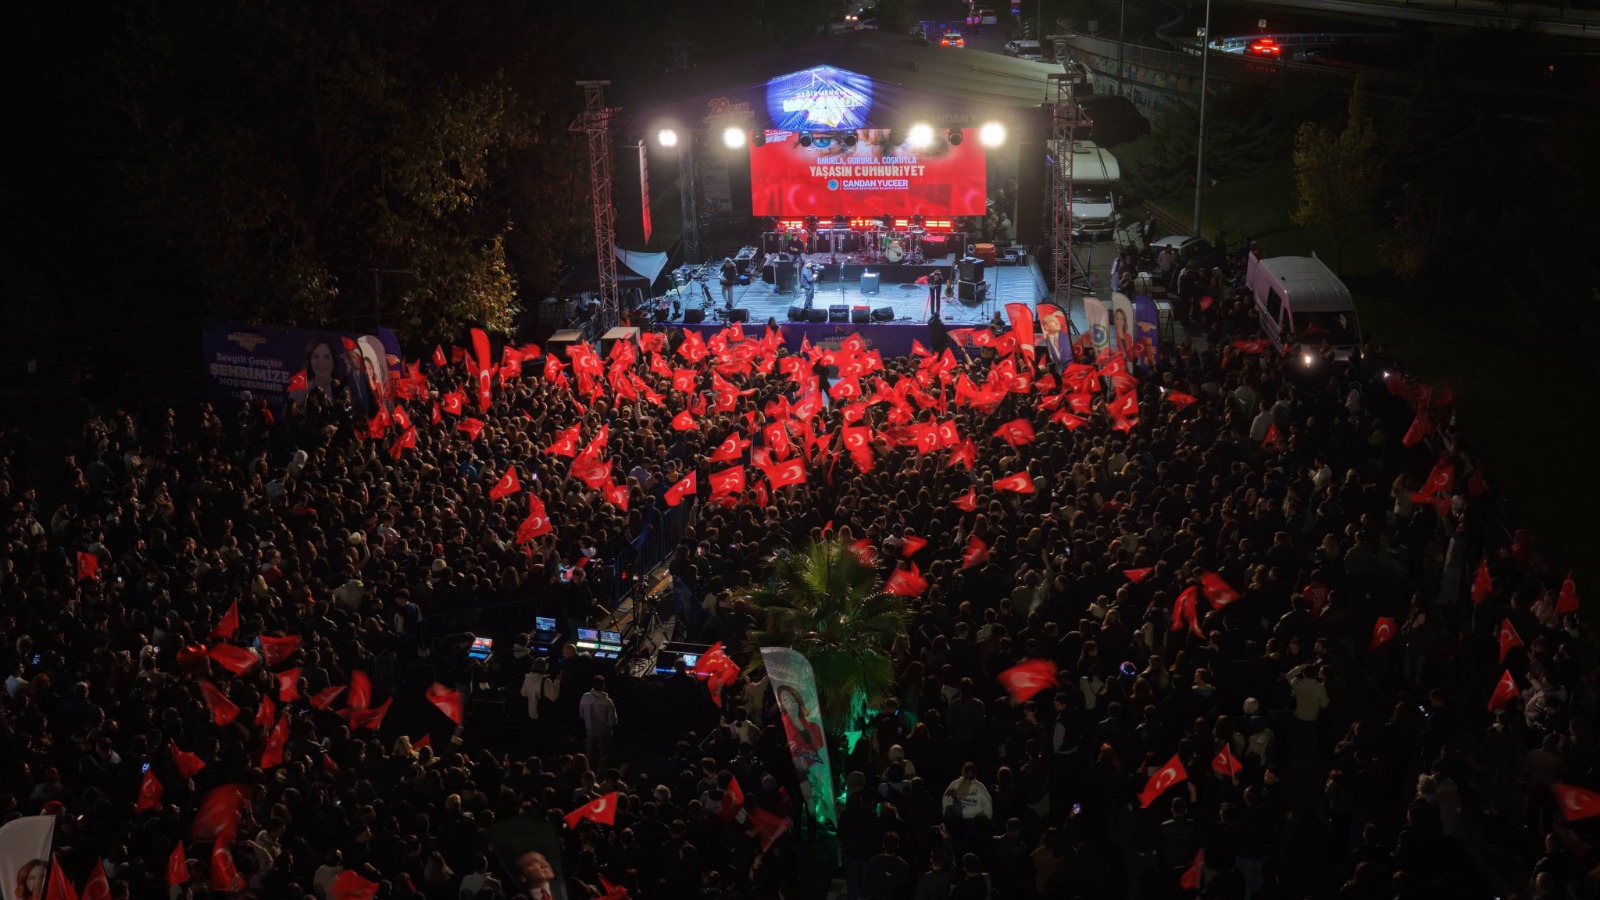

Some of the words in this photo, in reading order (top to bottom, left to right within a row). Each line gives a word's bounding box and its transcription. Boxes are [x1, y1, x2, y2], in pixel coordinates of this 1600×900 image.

[817, 156, 846, 166] ONURLA,
[809, 165, 852, 179] YAŞASIN
[843, 179, 876, 187] CANDAN
[216, 352, 246, 364] Sevgili
[248, 356, 284, 369] Gençler
[208, 362, 290, 384] ŞEHRİMİZE
[218, 376, 239, 388] HOŞ
